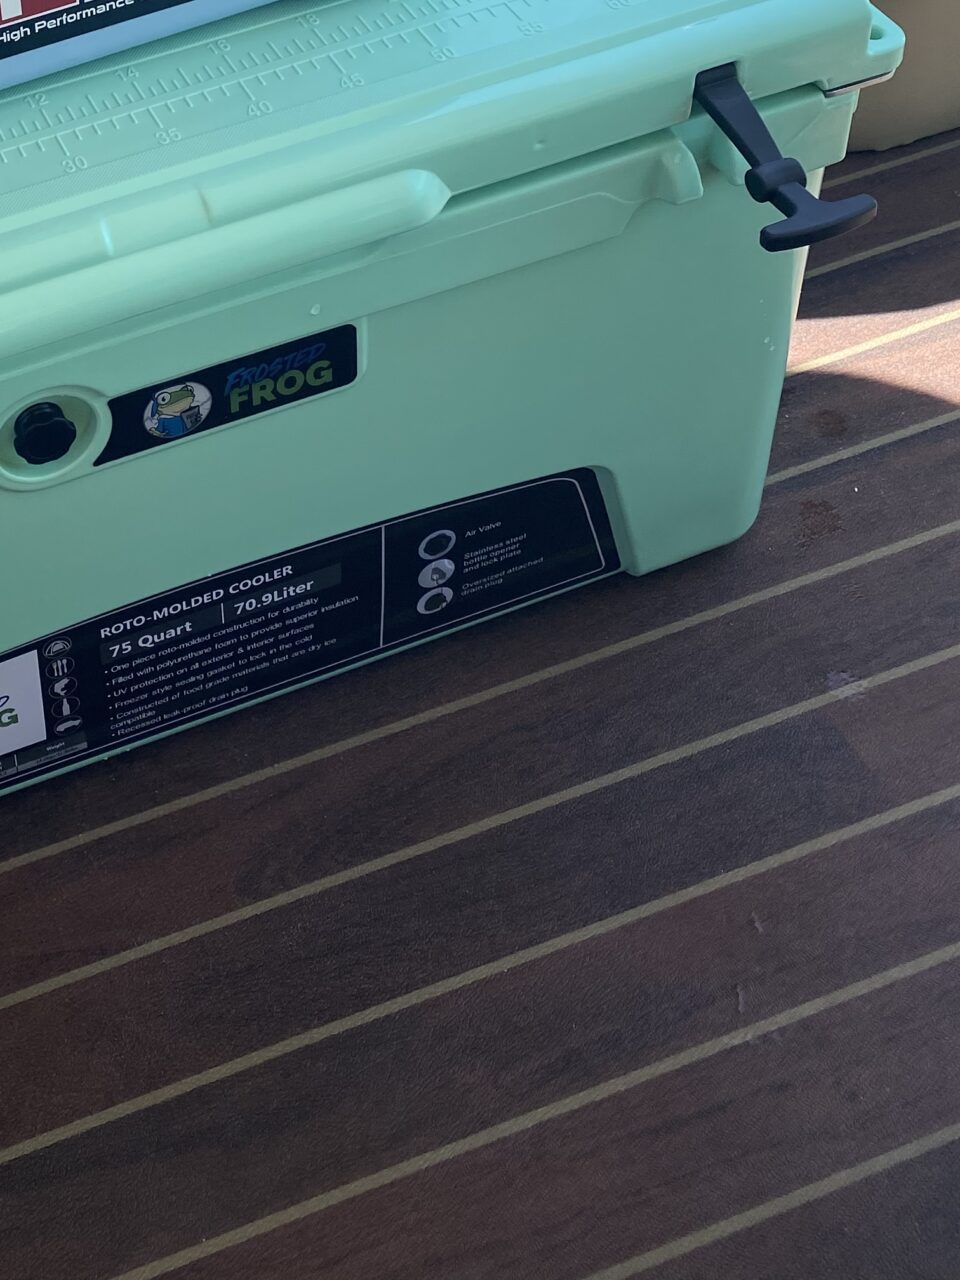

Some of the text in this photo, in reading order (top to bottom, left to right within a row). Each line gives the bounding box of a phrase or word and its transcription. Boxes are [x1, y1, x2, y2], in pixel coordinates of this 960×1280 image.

[24, 93, 49, 109] 12
[114, 66, 140, 82] 14
[207, 39, 231, 55] 16
[62, 155, 88, 174] 30
[155, 127, 182, 145] 35
[247, 99, 273, 118] 40
[340, 72, 365, 89] 45
[431, 46, 457, 63] 50
[517, 22, 543, 37] 55
[223, 342, 327, 397] FROSTED
[229, 359, 333, 414] FROG
[463, 542, 503, 560] Stainless
[465, 521, 502, 538] Air Valve
[489, 543, 520, 558] opener
[100, 565, 293, 639] ROTO-MOLDED COOLER
[463, 563, 479, 573] and
[109, 580, 315, 658] 75 Quart 70.9Liter
[110, 597, 319, 673] One piece roto-molded construction for durability
[111, 672, 134, 685] Filled
[136, 665, 155, 677] with
[156, 647, 212, 671] polyurethane
[214, 638, 237, 650] foam
[251, 622, 283, 639] provide
[285, 609, 319, 626] superior
[321, 595, 359, 612] insulation
[113, 687, 128, 697] UV
[130, 671, 174, 692] protection
[176, 667, 188, 676] on
[190, 662, 200, 671] all
[201, 650, 235, 667] exterior
[246, 636, 275, 651] interior
[278, 623, 315, 640] surfaces
[115, 634, 313, 709] Freezer style sealing gasket to lock in the cold
[116, 696, 169, 720] Constructed
[171, 692, 181, 701] of
[183, 684, 204, 696] food
[205, 675, 230, 690] grade
[272, 654, 289, 665] that
[308, 643, 322, 653] dry
[231, 685, 249, 696] plug
